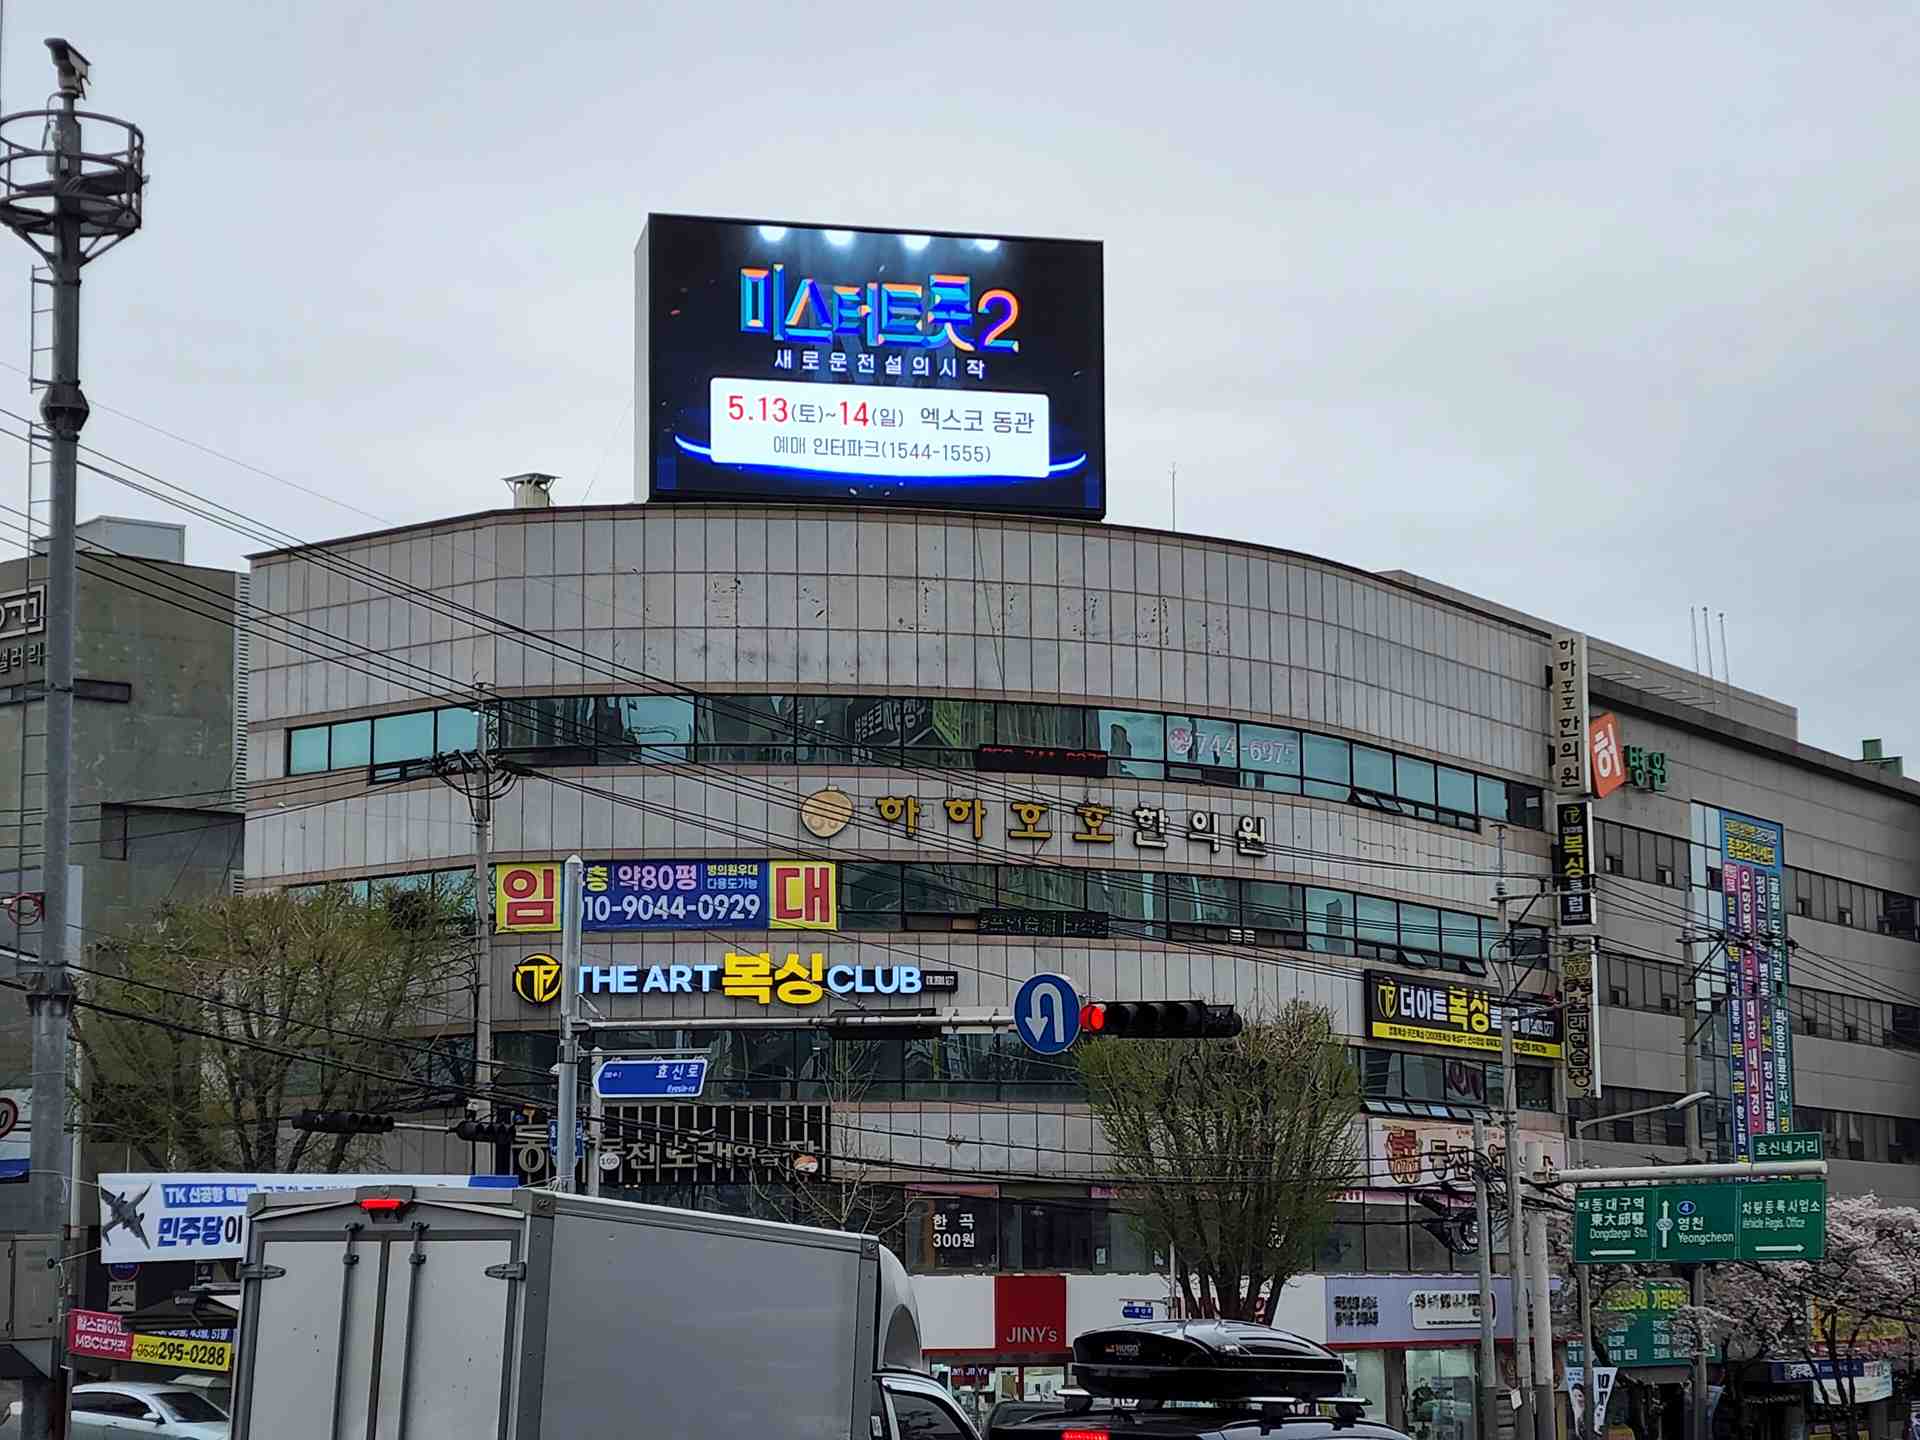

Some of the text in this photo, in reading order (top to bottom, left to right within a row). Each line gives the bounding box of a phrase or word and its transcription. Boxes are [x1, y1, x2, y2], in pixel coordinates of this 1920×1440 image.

[739, 263, 1019, 352] 미스터트롯2
[920, 407, 984, 432] 엑스코
[992, 409, 1034, 434] 동관
[773, 436, 806, 455] 예매
[581, 864, 697, 892] 층 약80평
[502, 868, 555, 926] 임
[775, 866, 831, 923] 대
[581, 893, 761, 921] 10-9044-0929
[642, 964, 718, 993] ART
[722, 952, 824, 1005] 복싱
[827, 964, 922, 994] CLUB
[656, 1064, 698, 1080] 효신로
[165, 1188, 187, 1204] TK
[932, 1213, 975, 1230] 한 곡
[1678, 1216, 1704, 1231] 영천
[932, 1232, 975, 1248] 300원
[1678, 1231, 1734, 1246] Yeongcheon
[1006, 1325, 1057, 1343] JINY's
